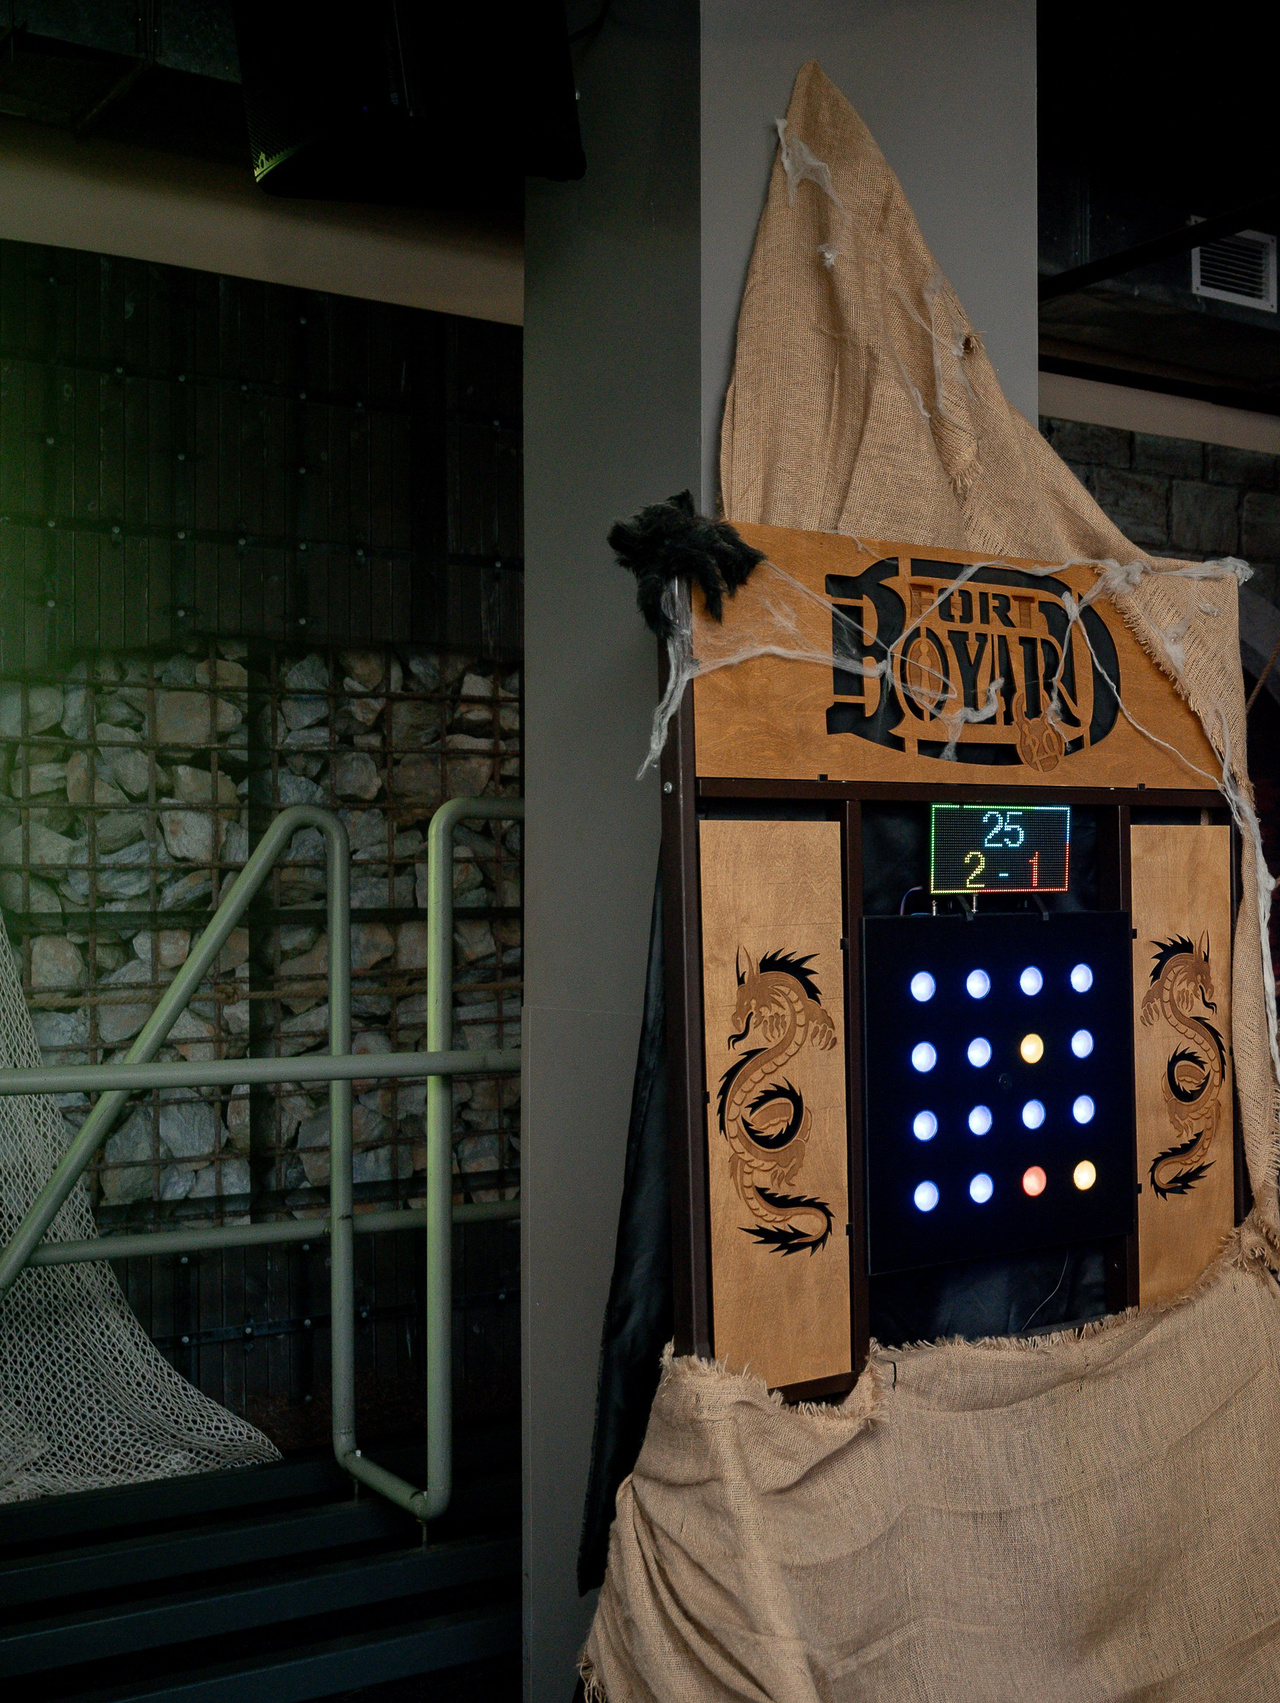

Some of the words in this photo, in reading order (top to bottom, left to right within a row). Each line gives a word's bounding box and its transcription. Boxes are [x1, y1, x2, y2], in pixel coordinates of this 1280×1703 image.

[910, 583, 1036, 630] FORT
[982, 811, 1025, 848] 25
[964, 851, 986, 888] 2
[1028, 851, 1039, 887] 1
